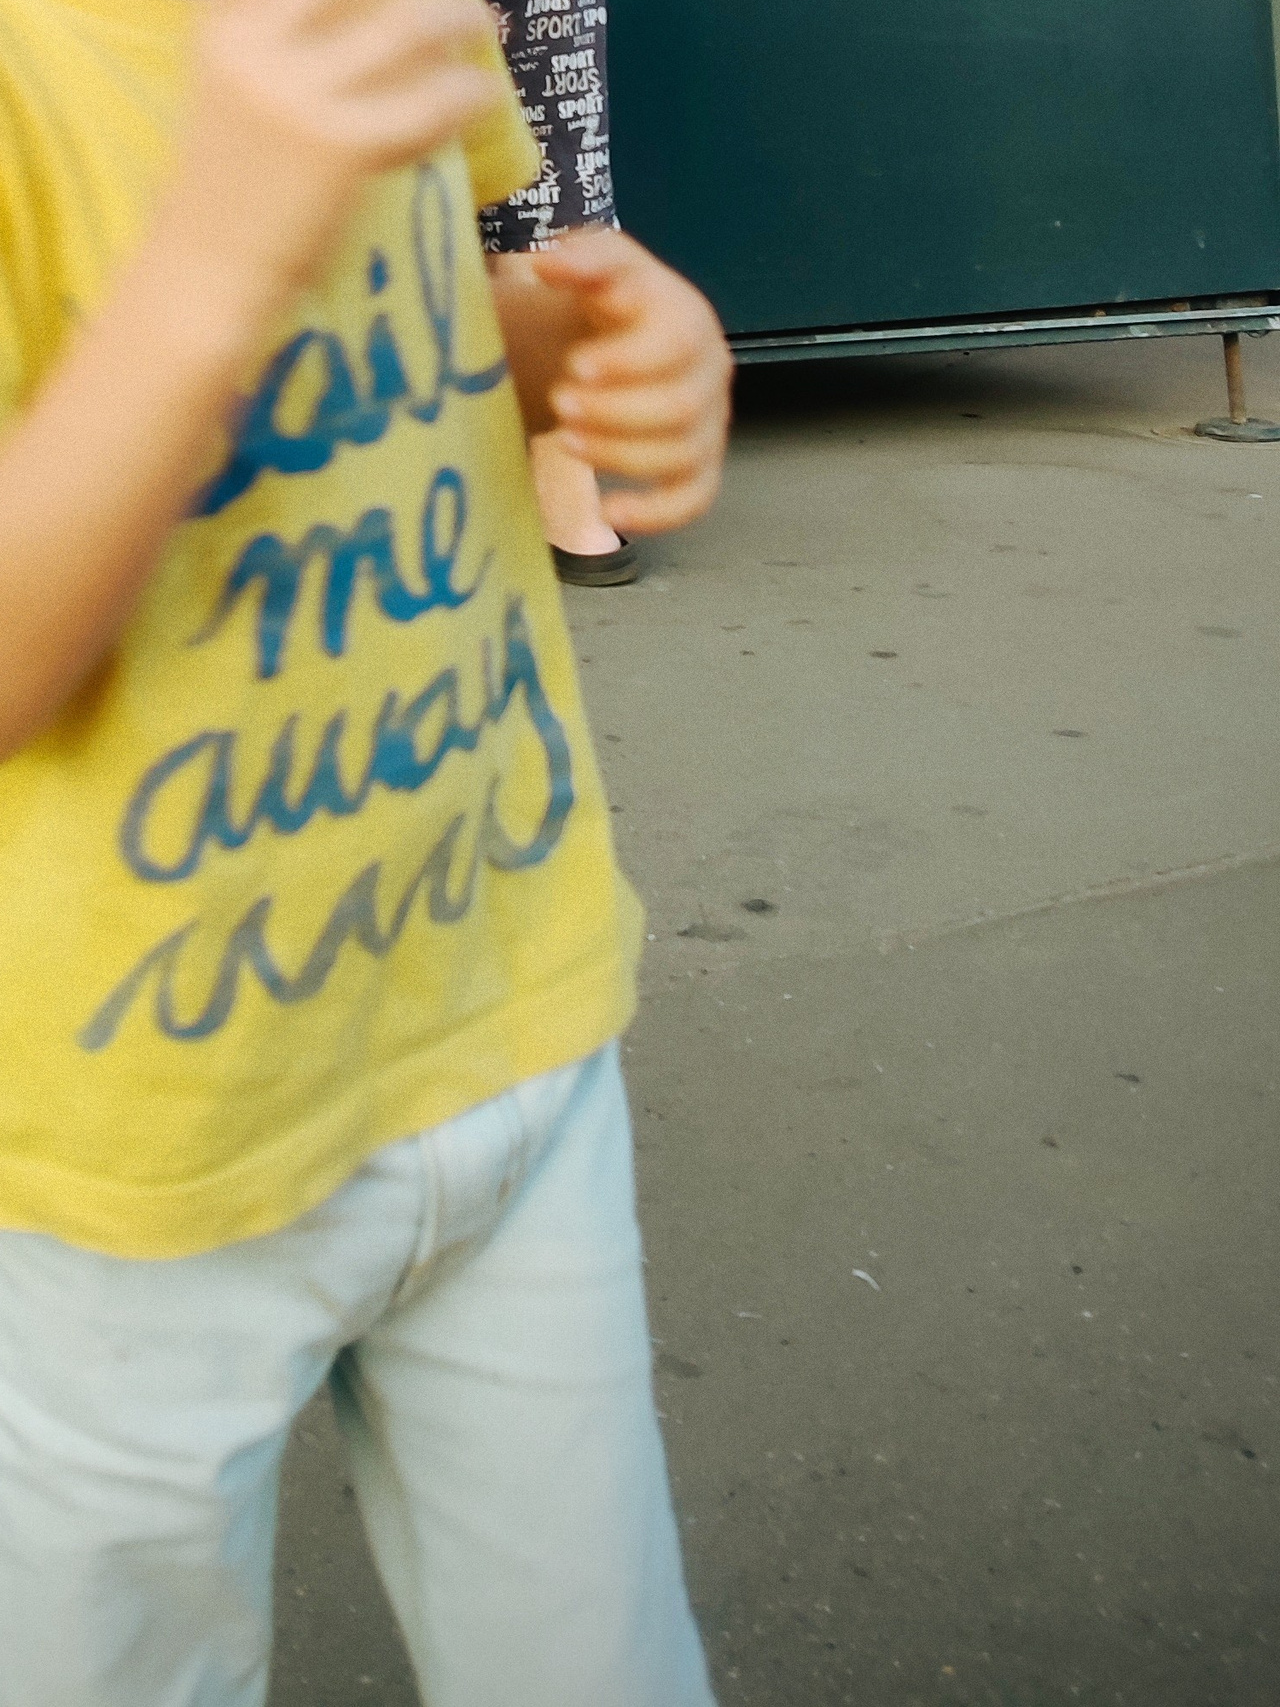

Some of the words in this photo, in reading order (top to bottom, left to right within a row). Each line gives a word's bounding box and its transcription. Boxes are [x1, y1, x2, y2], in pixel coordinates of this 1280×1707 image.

[525, 12, 582, 42] SPORT
[550, 49, 596, 73] SPORT
[541, 67, 601, 97] SPORT
[557, 93, 604, 120] SPORT
[507, 185, 561, 207] SPORT
[193, 161, 509, 518] ail
[187, 466, 495, 683] me
[118, 592, 576, 885] away
